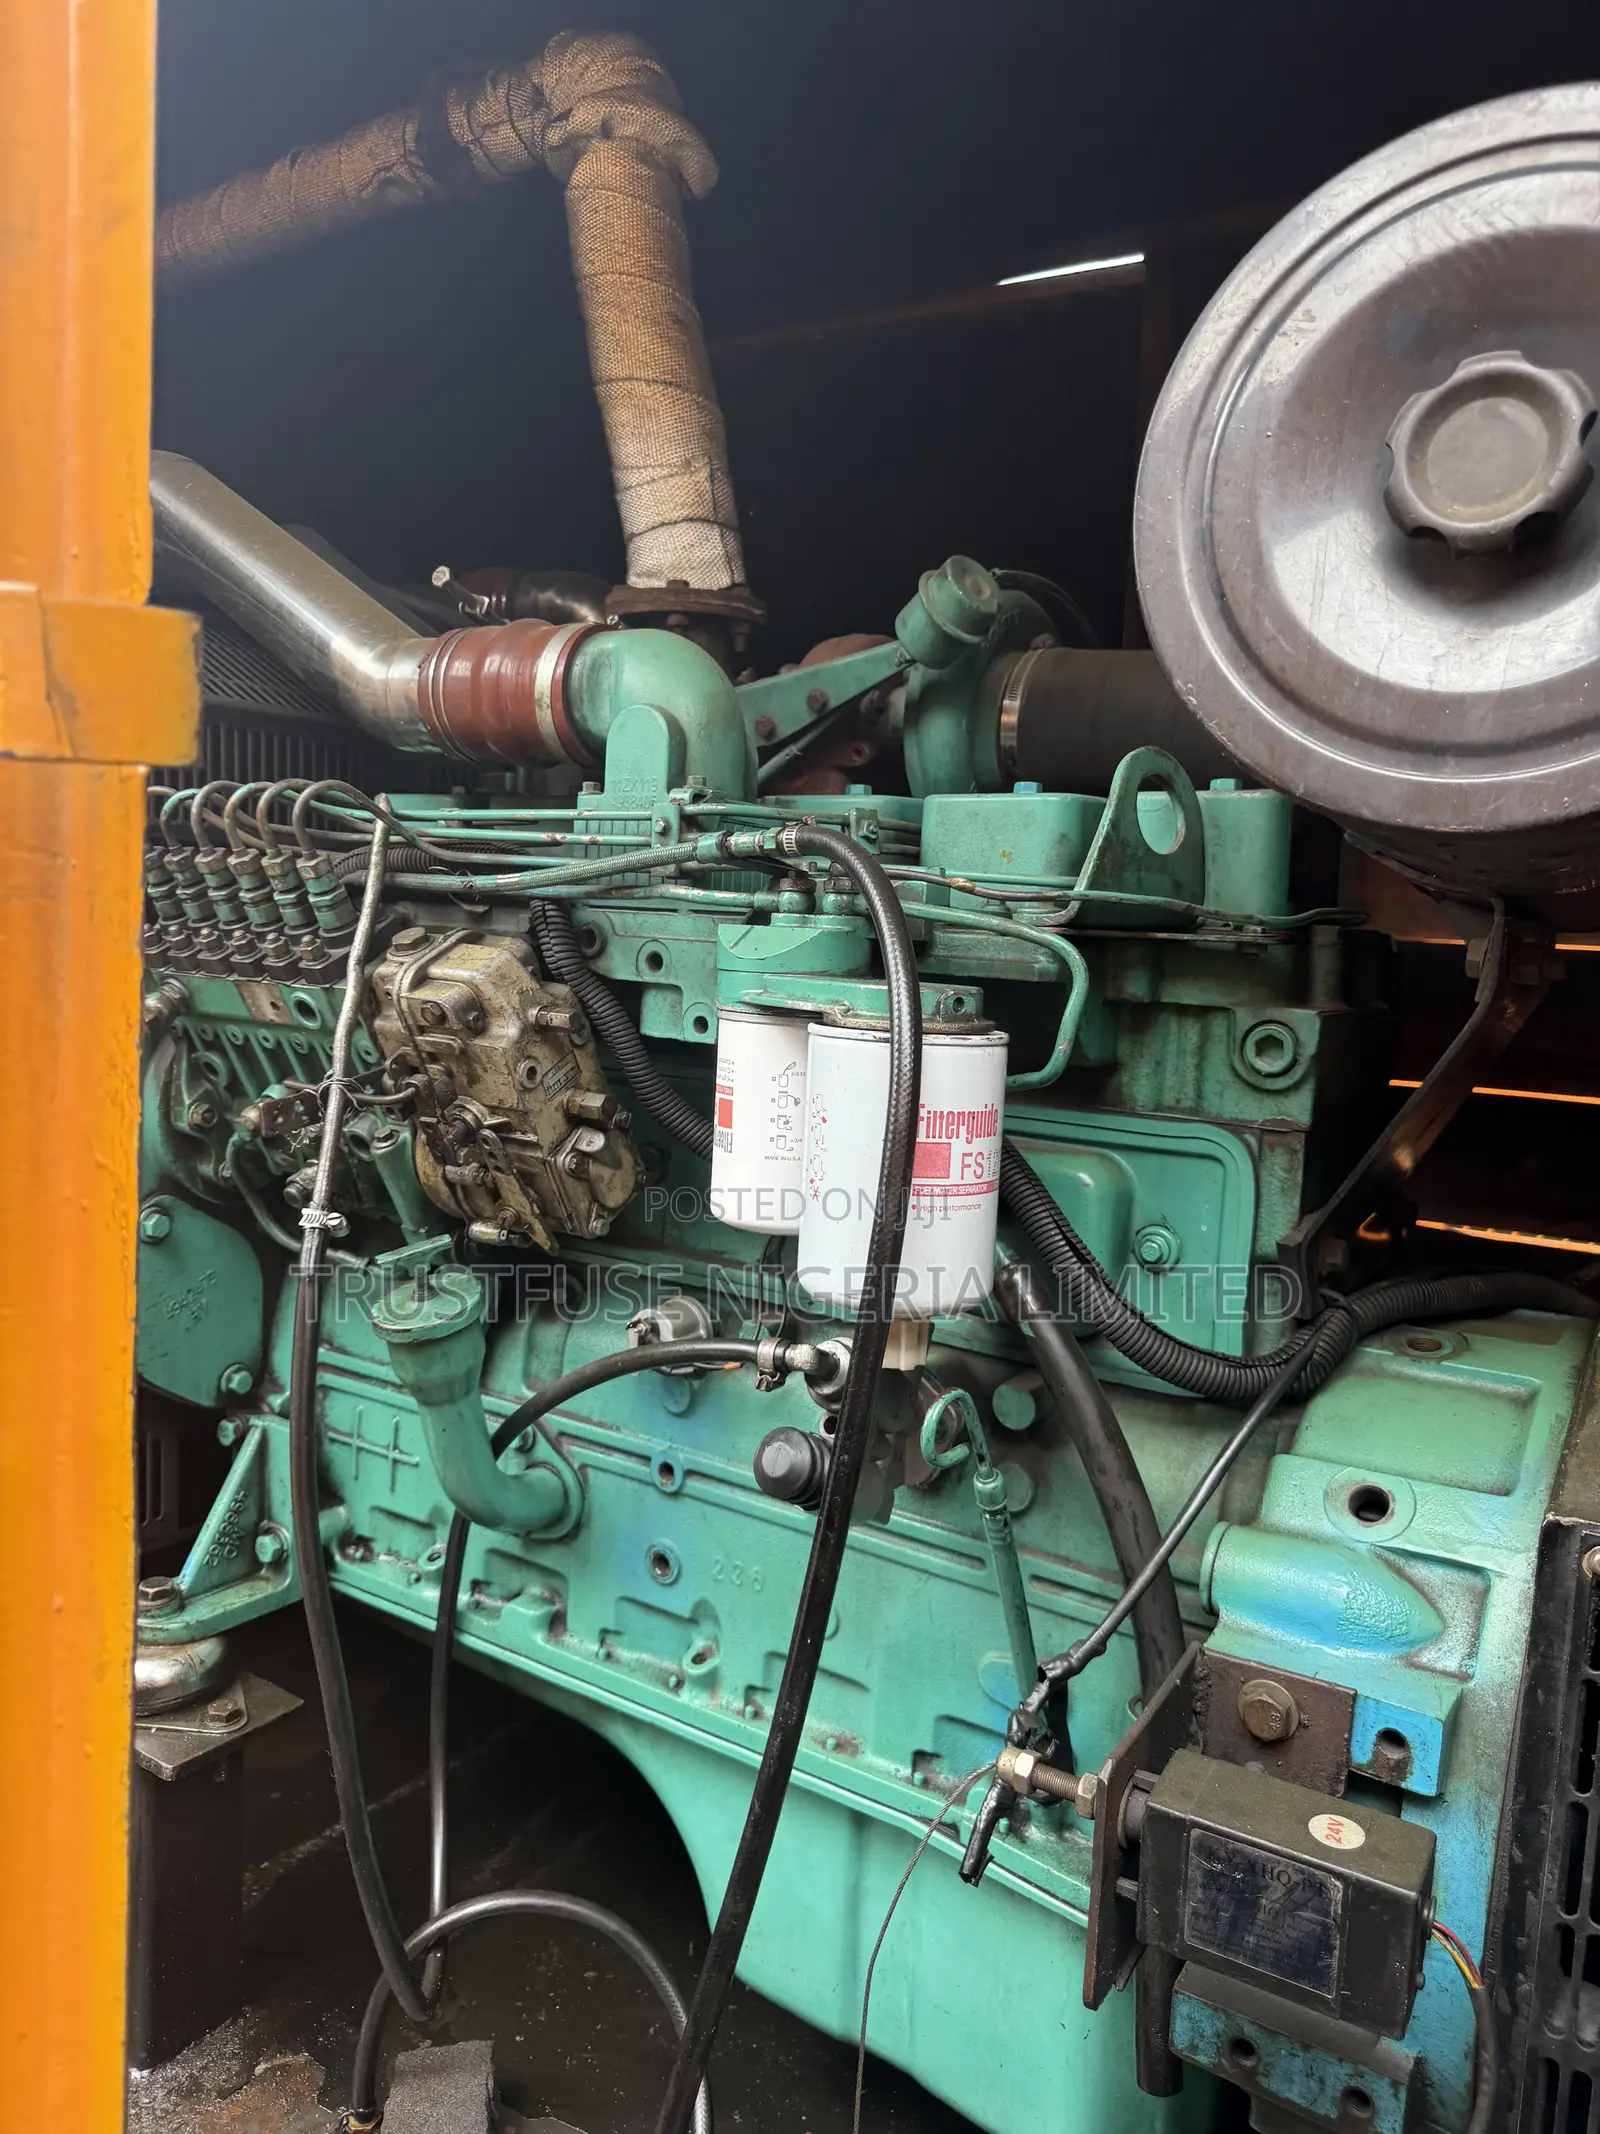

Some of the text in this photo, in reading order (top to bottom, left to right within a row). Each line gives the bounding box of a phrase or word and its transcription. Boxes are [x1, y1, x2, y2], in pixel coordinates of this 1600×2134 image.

[916, 1103, 999, 1145] Filterguide
[920, 1202, 982, 1214] High performance
[1324, 1816, 1345, 1845] 24V
